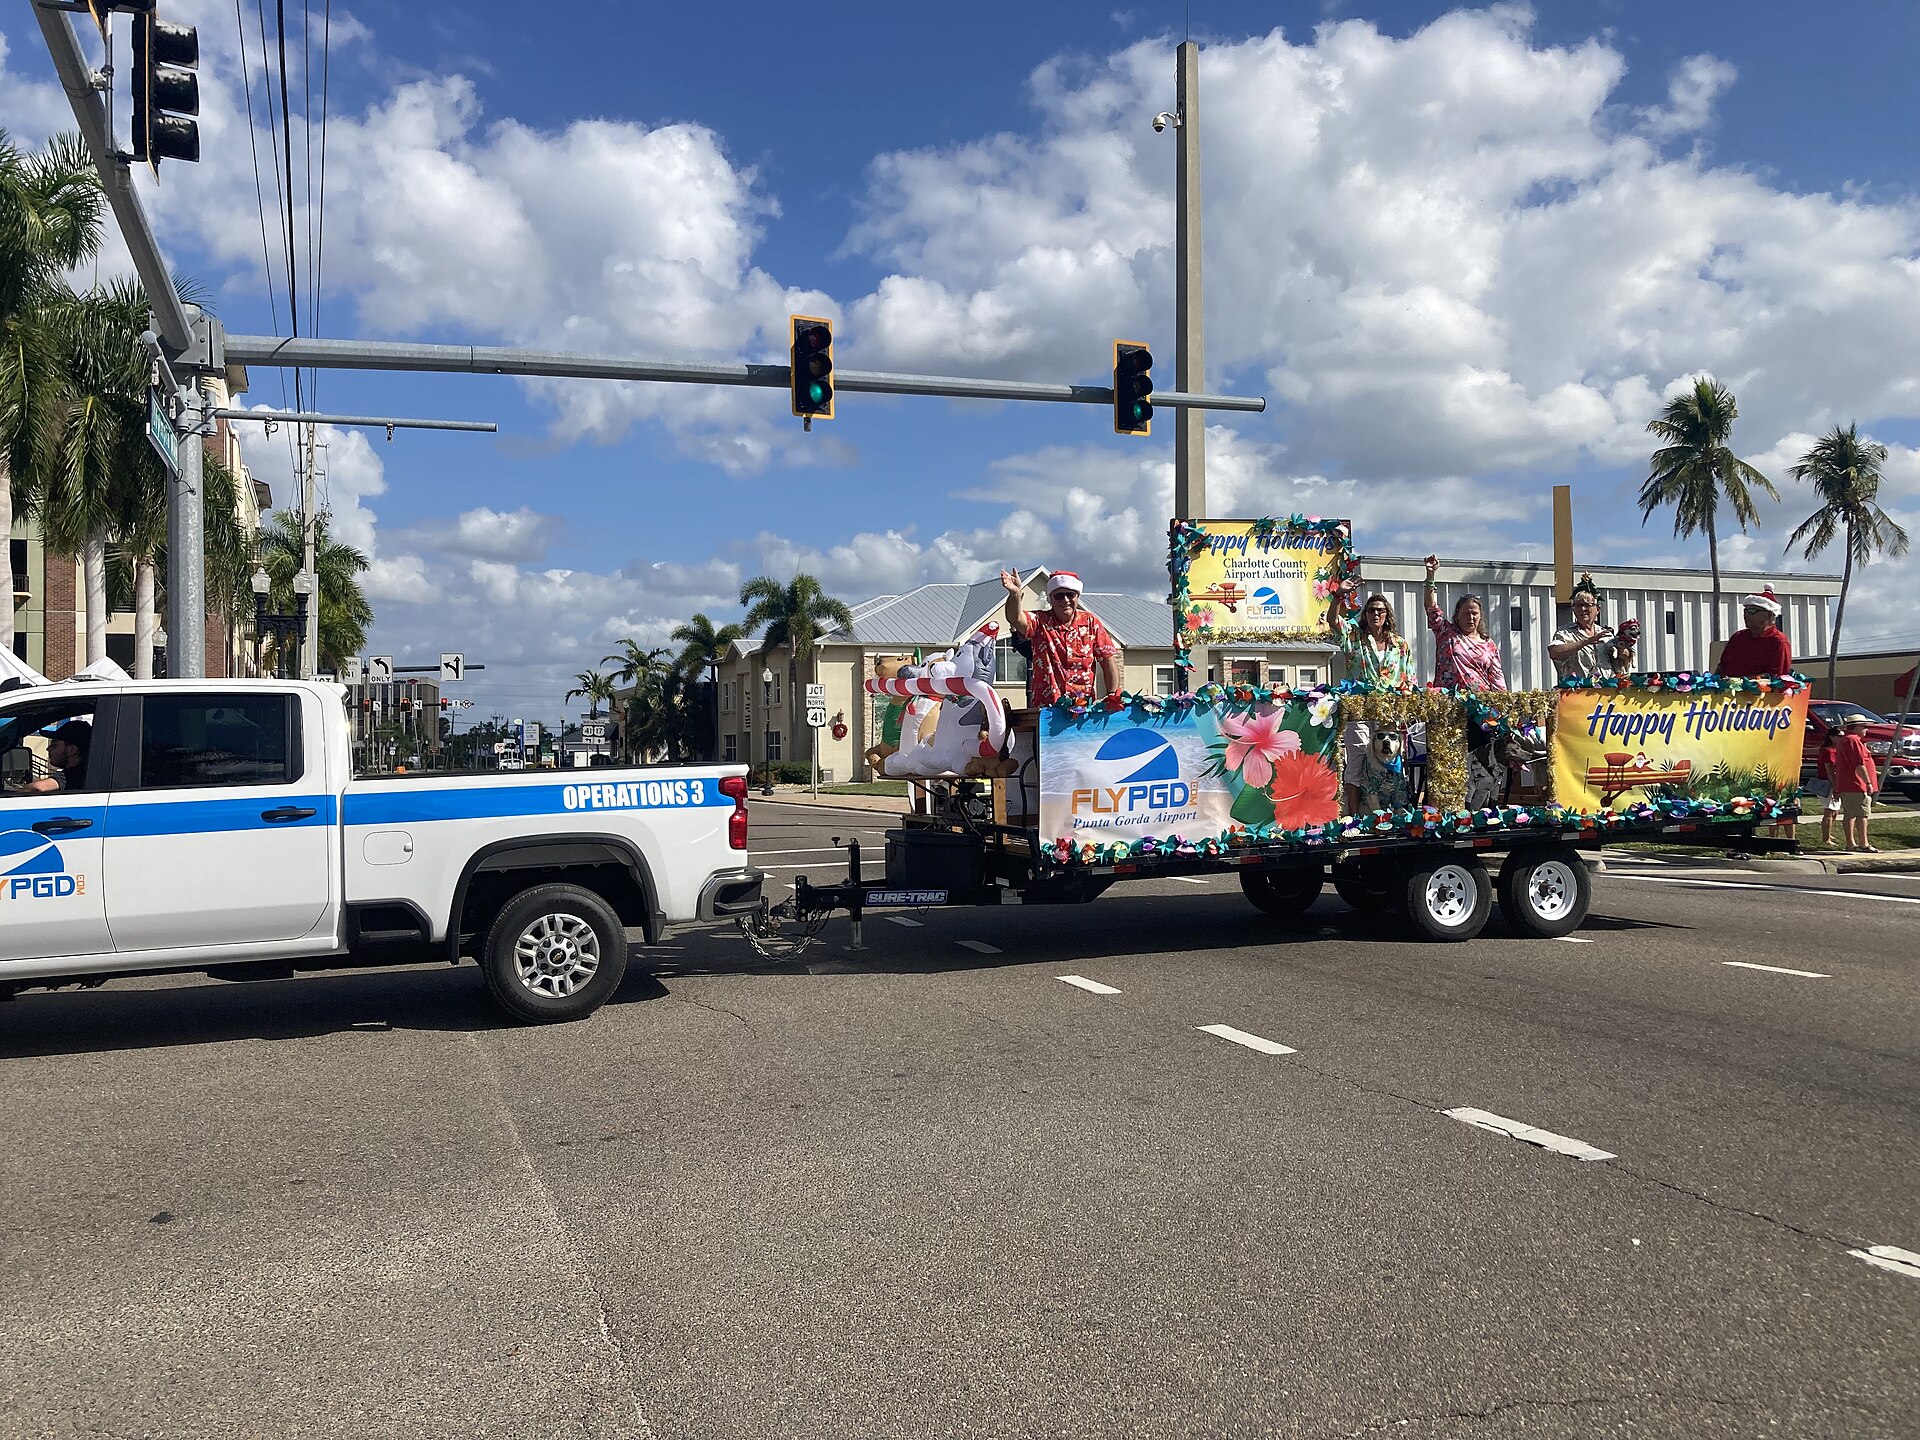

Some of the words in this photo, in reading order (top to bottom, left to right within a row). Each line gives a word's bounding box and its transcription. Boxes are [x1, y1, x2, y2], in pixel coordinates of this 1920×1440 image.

[1255, 527, 1335, 557] Holidays
[1223, 558, 1270, 569] Charlotte
[1272, 558, 1309, 570] County
[1223, 569, 1260, 581] Airport
[1262, 568, 1309, 581] Authority
[1246, 605, 1284, 615] FLYPGD
[809, 686, 823, 695] JCT
[810, 712, 823, 723] 41
[1587, 702, 1677, 747] Happy
[1683, 699, 1793, 741] Holidays
[562, 781, 688, 810] OPERATIONS
[690, 780, 705, 805] 3
[1071, 782, 1190, 815] FLYPGD
[1073, 818, 1110, 829] Punta
[1114, 814, 1150, 826] Gorda
[1153, 811, 1197, 824] Airport
[868, 892, 945, 902] SURE-TRAC
